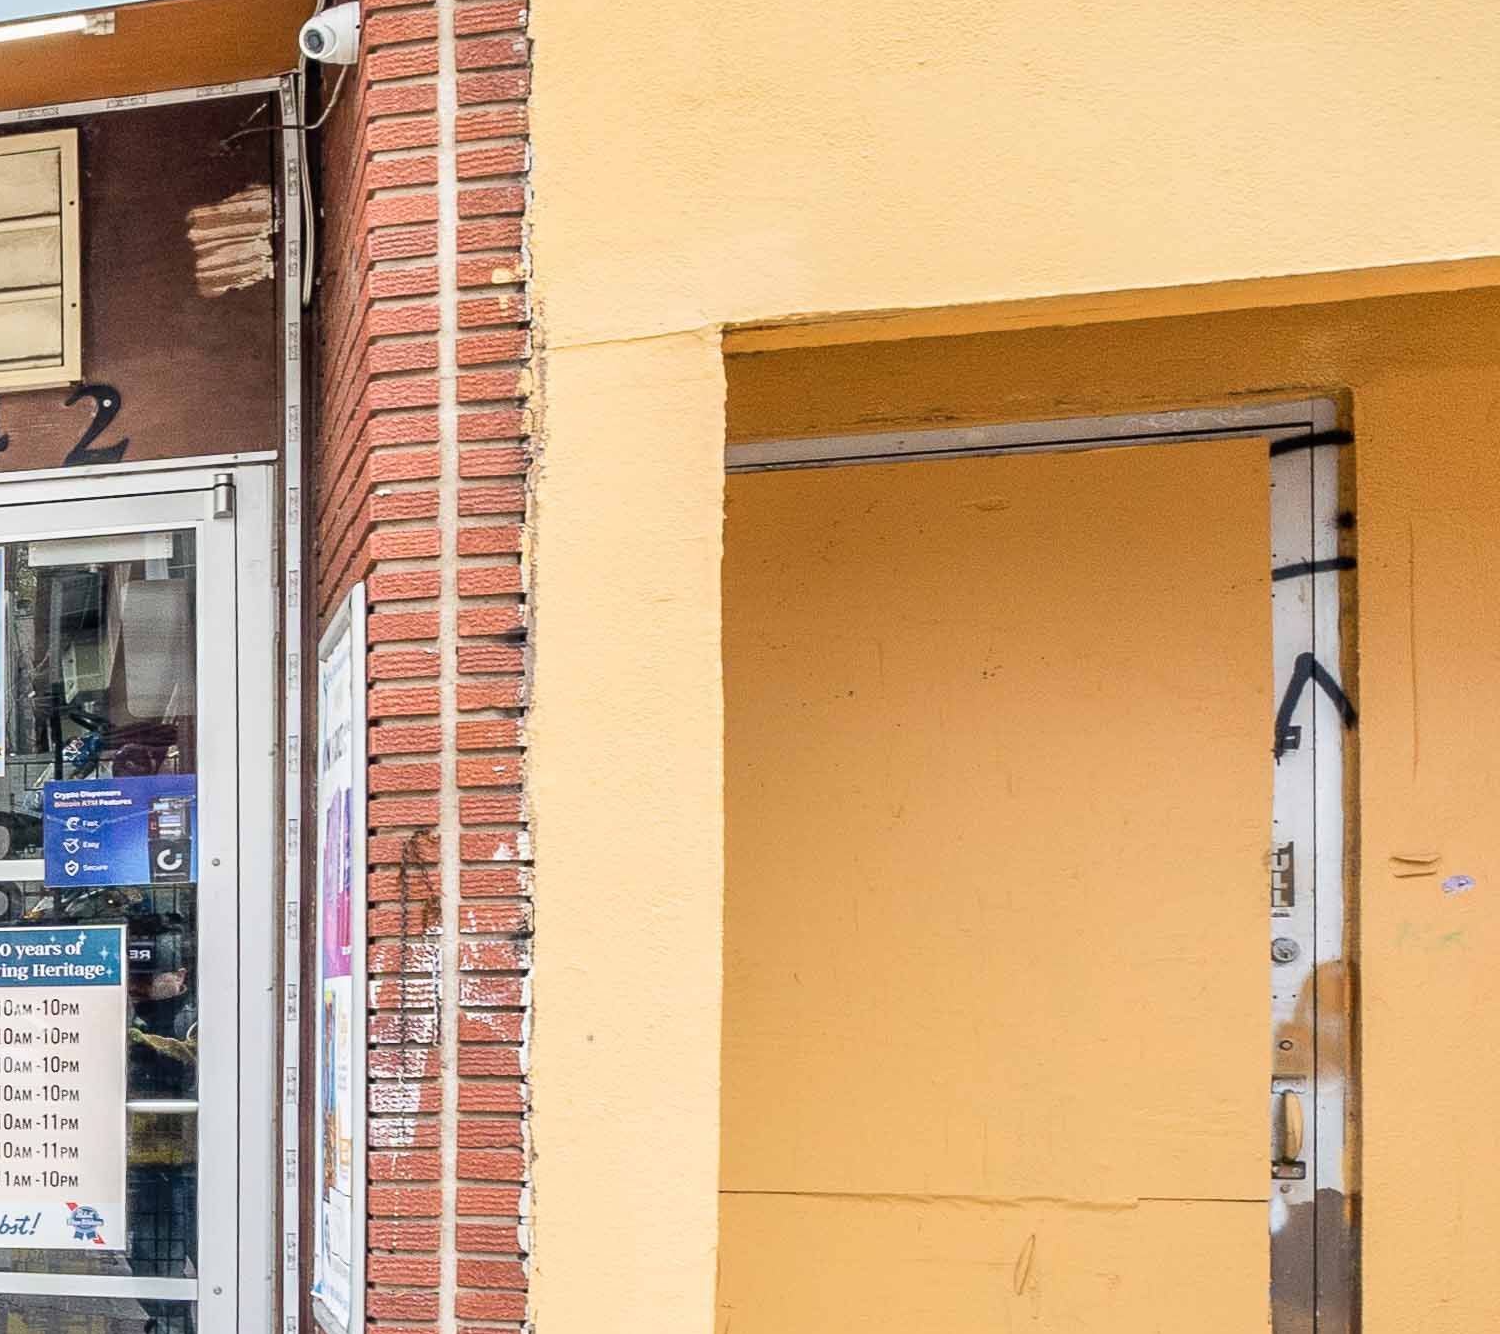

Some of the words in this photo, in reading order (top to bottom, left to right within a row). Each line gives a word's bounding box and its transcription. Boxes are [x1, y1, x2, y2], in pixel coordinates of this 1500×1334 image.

[17, 941, 60, 959] years
[65, 940, 83, 955] of
[33, 963, 106, 979] Heritage
